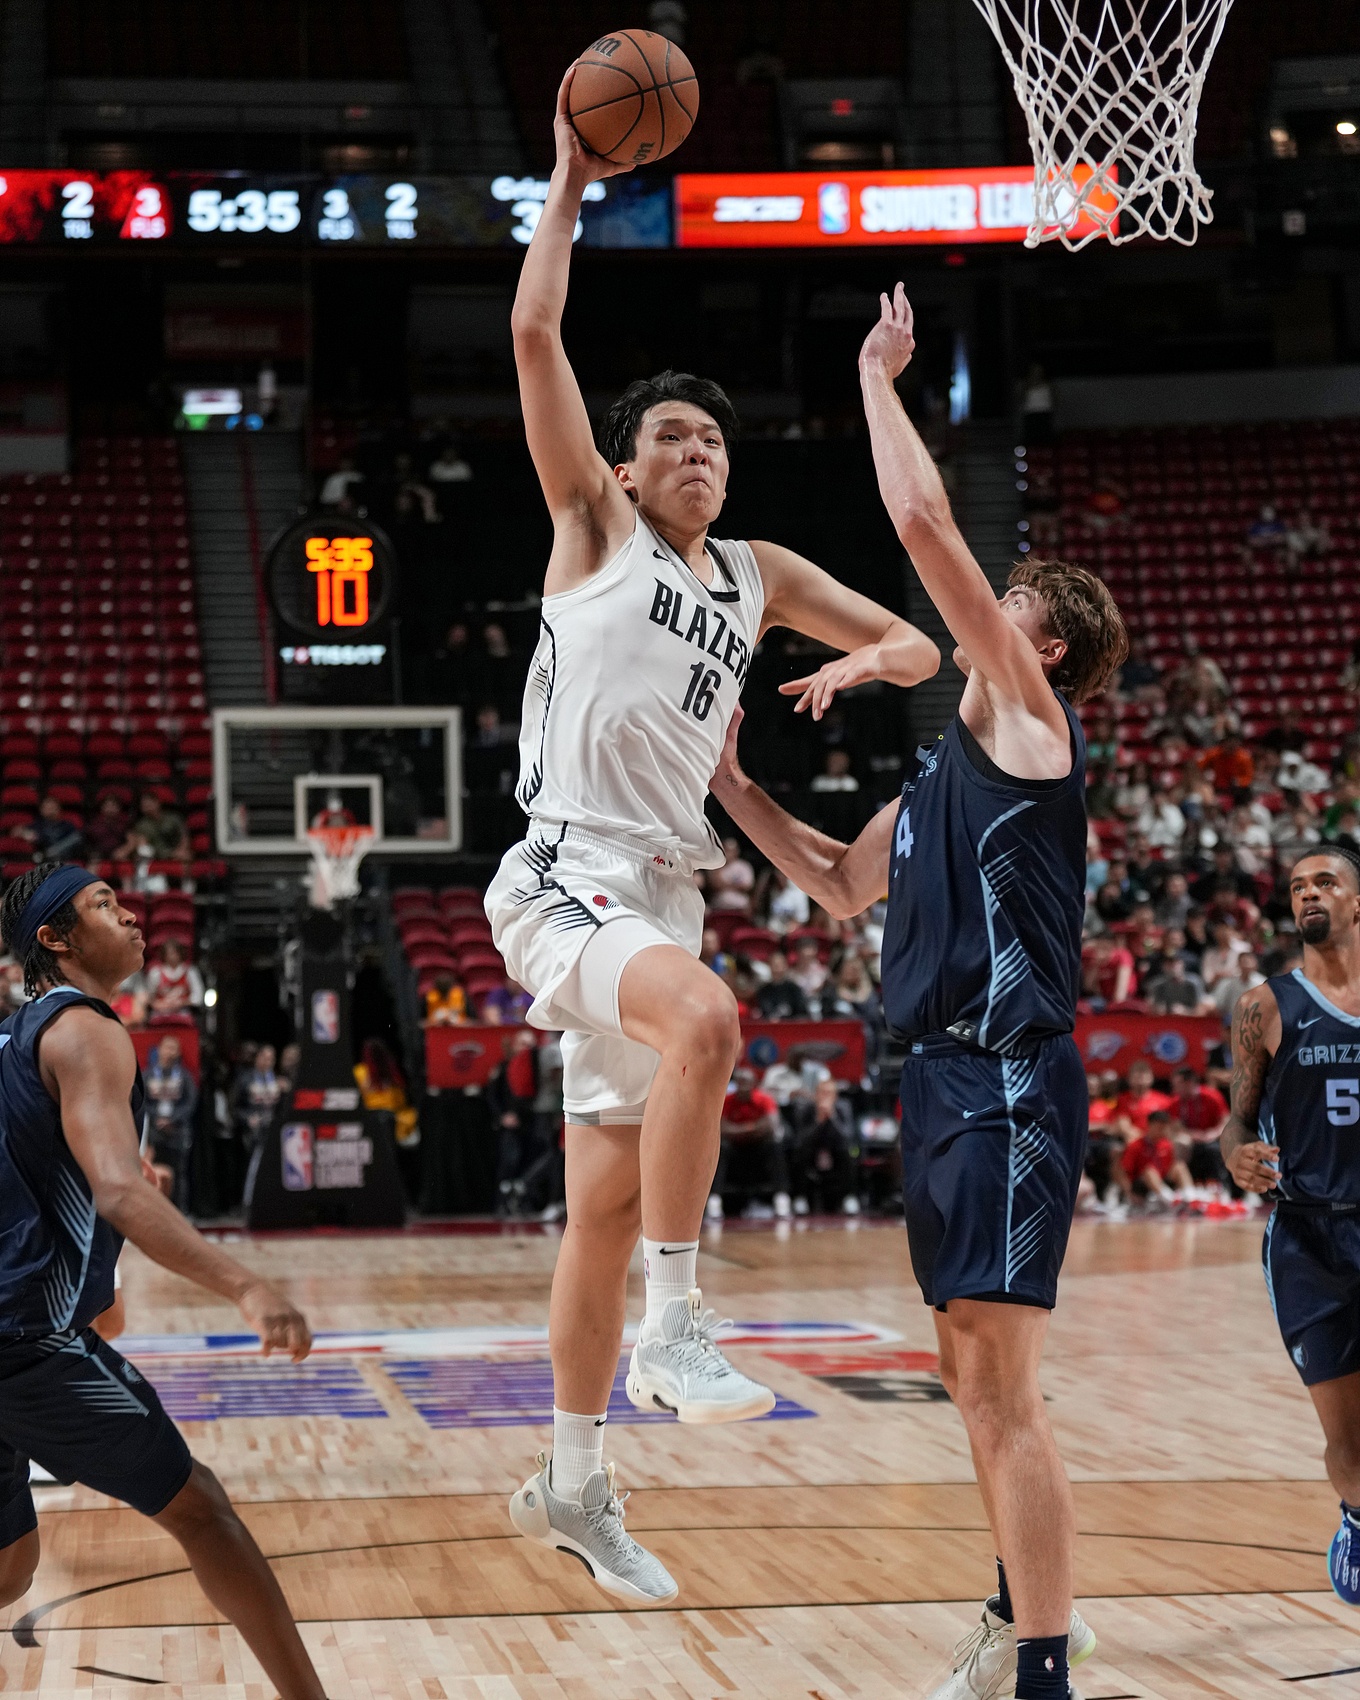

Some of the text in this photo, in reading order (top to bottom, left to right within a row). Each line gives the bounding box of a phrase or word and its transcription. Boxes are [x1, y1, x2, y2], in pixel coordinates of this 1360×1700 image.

[62, 181, 94, 218] 2
[136, 187, 161, 217] 3
[187, 190, 301, 232] 5:35
[323, 189, 350, 219] 3
[385, 183, 418, 220] 2
[511, 200, 583, 244] 3
[316, 570, 369, 627] 10
[681, 661, 722, 722] 16
[1326, 1078, 1360, 1127] 5
